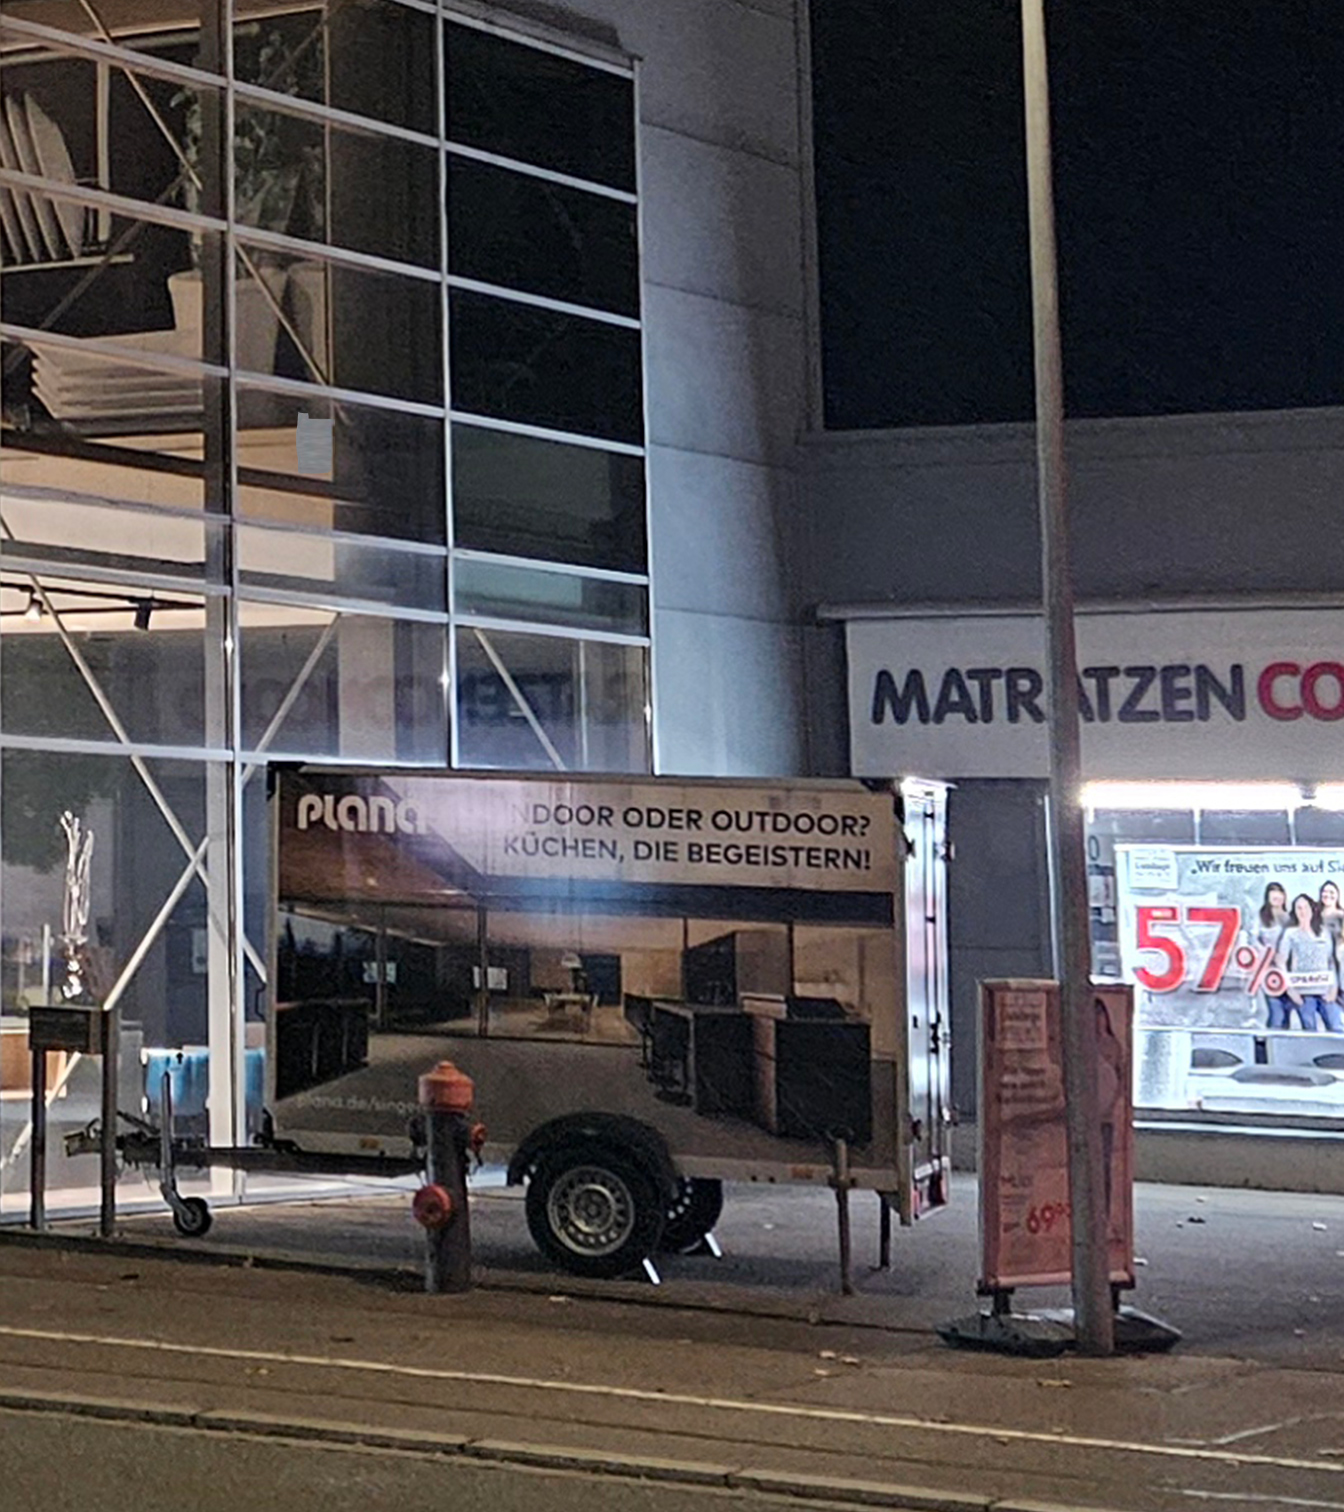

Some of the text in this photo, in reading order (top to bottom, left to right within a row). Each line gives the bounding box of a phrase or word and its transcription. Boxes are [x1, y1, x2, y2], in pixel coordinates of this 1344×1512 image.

[508, 803, 872, 838] NDOOR ODER OUTDOOR?
[503, 831, 872, 871] KÜCHEN, DIE BEGEISTERN!
[1133, 906, 1286, 996] 57%
